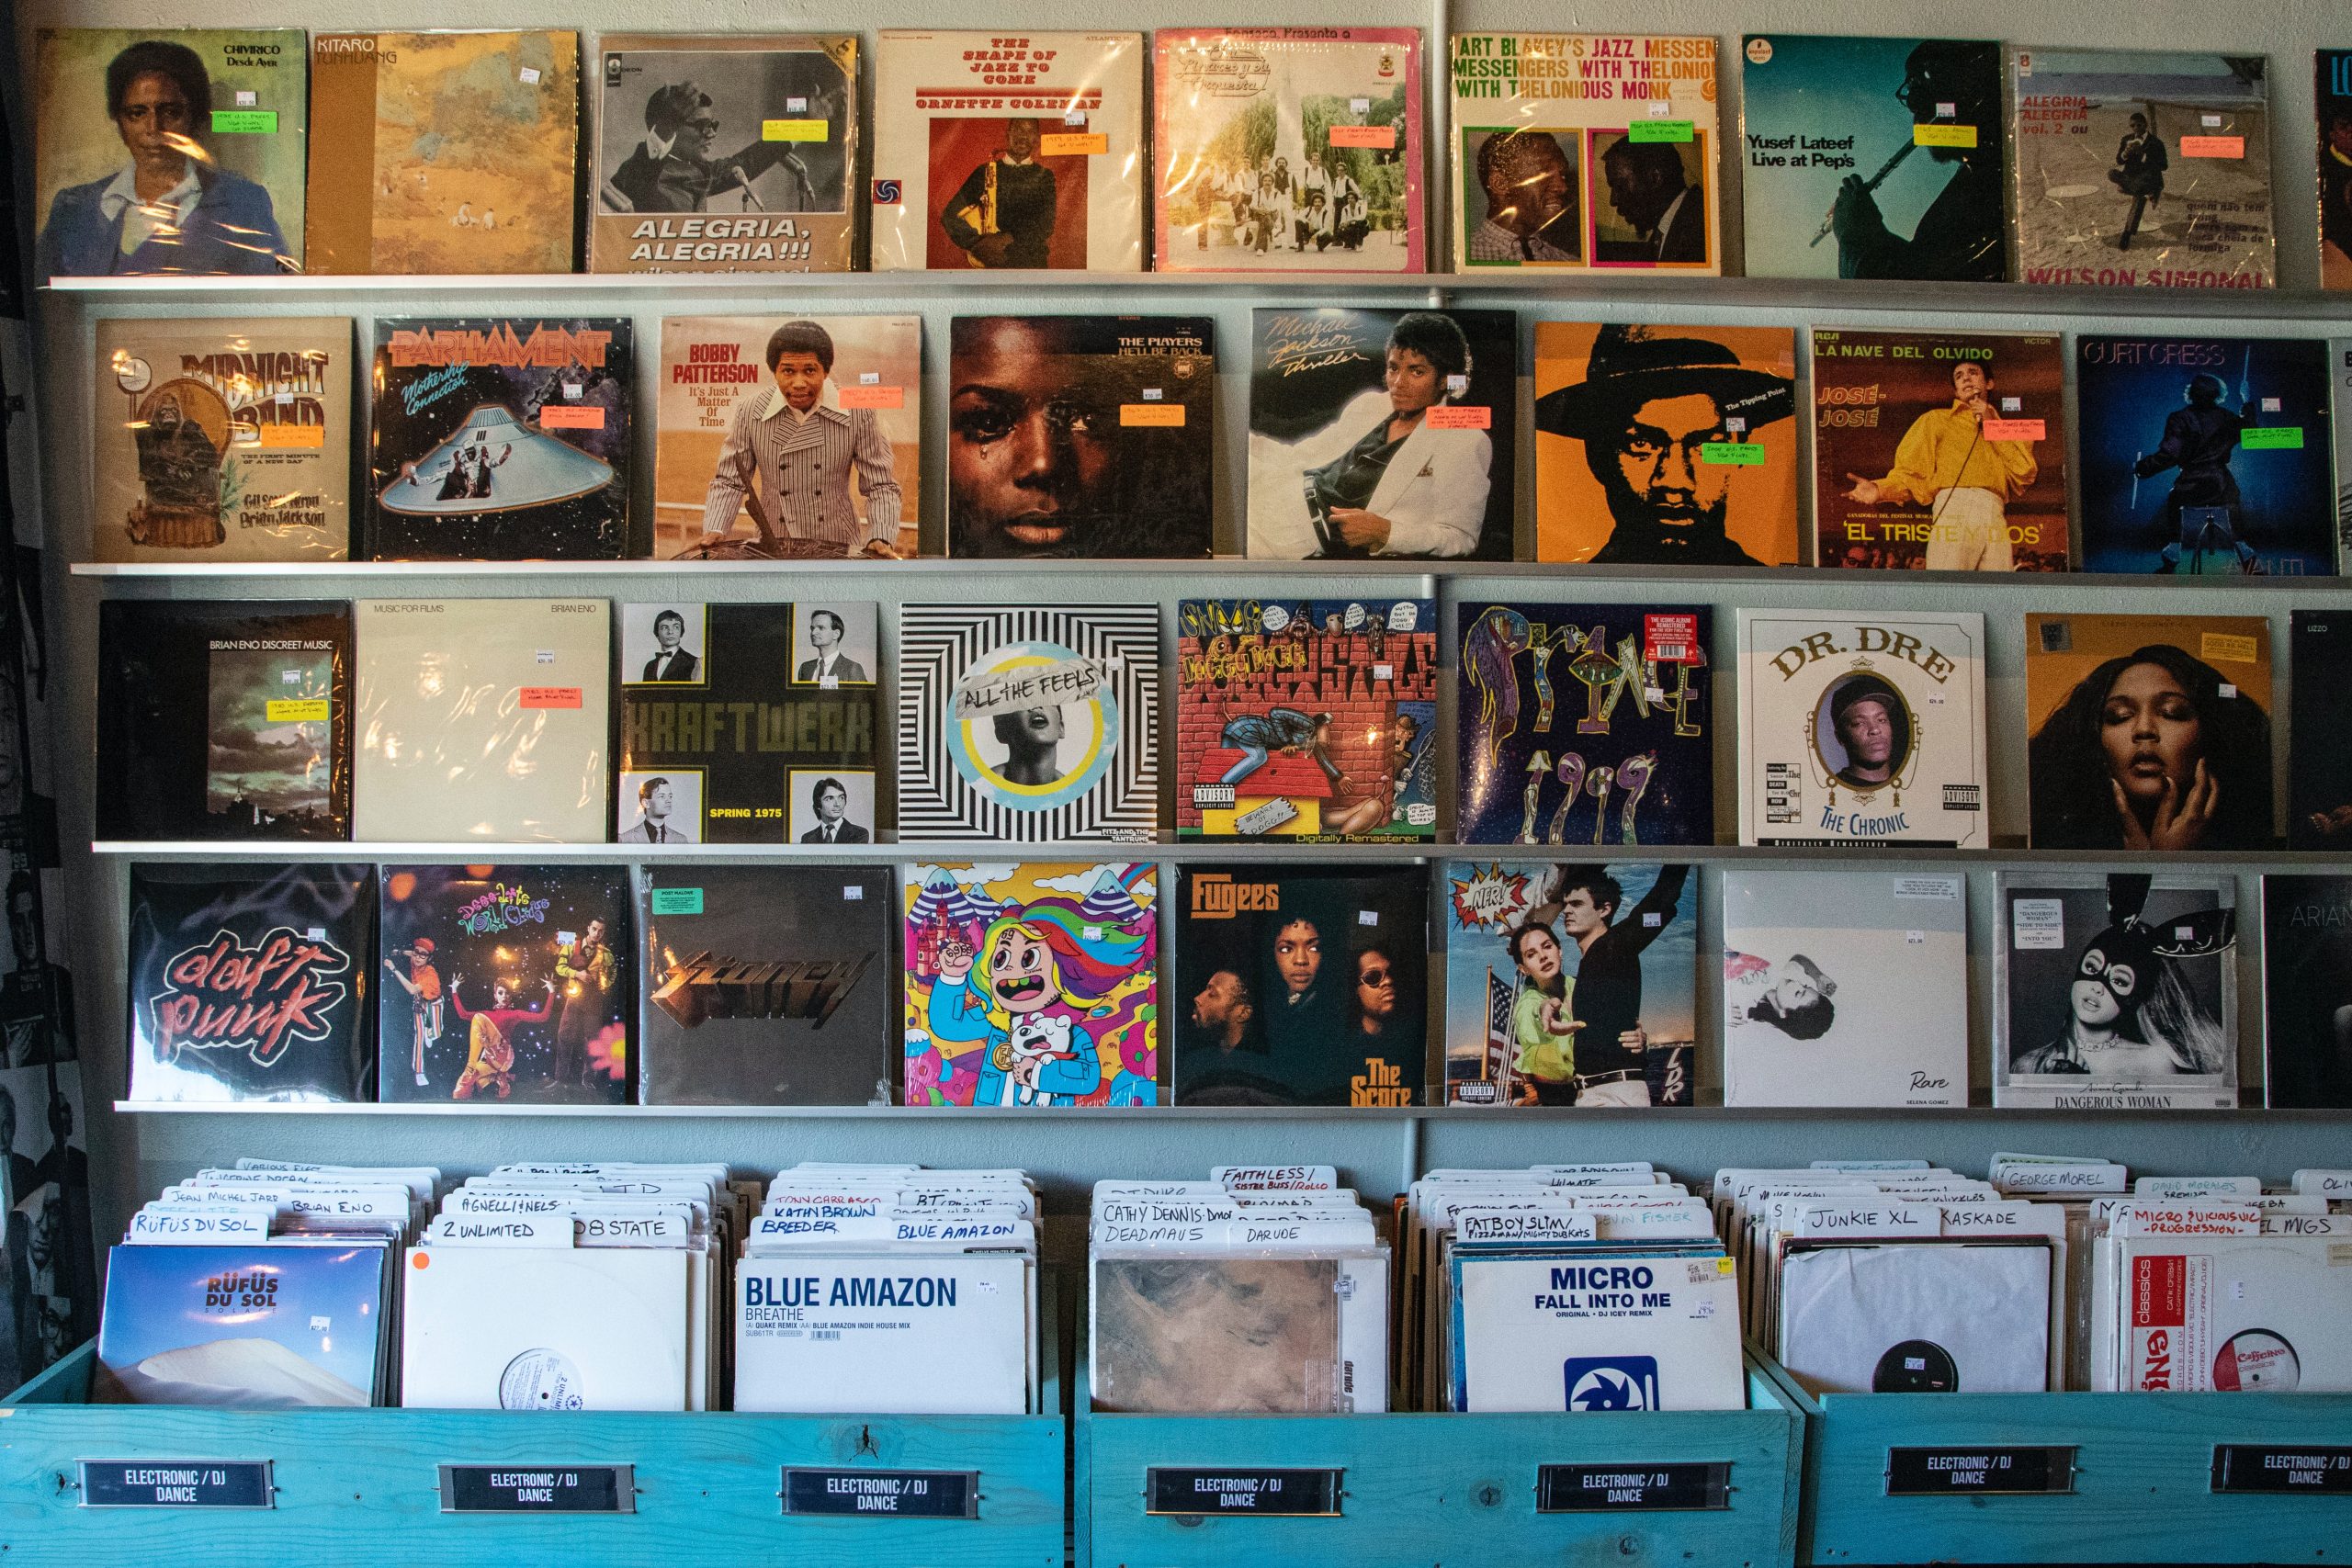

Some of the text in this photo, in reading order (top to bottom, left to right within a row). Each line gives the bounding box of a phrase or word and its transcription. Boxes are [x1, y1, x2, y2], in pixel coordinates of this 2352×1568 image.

[223, 45, 281, 55] CHIVIRICO
[317, 39, 375, 52] KITARO
[990, 39, 1030, 48] THE
[1459, 38, 1634, 58] ART BLAKEY'S JAZZ
[316, 51, 397, 64] TUNHUANG
[962, 51, 1057, 61] SHAPE OF
[969, 62, 1050, 73] JAZZ TO
[1453, 59, 1623, 79] MESSENGERS WITH
[983, 74, 1036, 85] COME
[1455, 79, 1672, 100] WITH THELONIOUS MONK
[915, 99, 1102, 109] ORNETTE COLEMAN
[2022, 96, 2087, 107] ALEGRIA
[2022, 109, 2088, 120] ALEGRIA
[1747, 135, 1855, 150] Yusef Lateef
[1751, 152, 1855, 170] Live at Pep's
[631, 219, 810, 240] ALEGRIA,
[629, 243, 810, 261] ALEGRIA!!!
[2027, 268, 2266, 288] WILSON SIMONAL
[1265, 313, 1363, 340] Michael
[387, 321, 613, 372] PARLIAMENT
[1118, 337, 1203, 346] THE PLAYERS
[689, 344, 741, 363] BOBBY
[1170, 347, 1203, 356] BACK
[1815, 344, 1994, 360] LA NAVE DEL OLVIDO
[2085, 342, 2224, 366] CURT CRESS
[1283, 351, 1370, 378] Thriller
[673, 364, 759, 383] PATTERSON
[180, 352, 329, 410] MIDNIGHT
[401, 359, 471, 403] Mothership
[405, 376, 469, 416] Connection
[707, 387, 729, 397] Just
[1739, 393, 1768, 406] Tipping
[1766, 387, 1786, 398] Point
[697, 397, 731, 407] Matter
[707, 407, 718, 417] Of
[1819, 406, 1880, 427] JOSÉ
[699, 416, 725, 426] Time
[374, 604, 445, 613] MUSIC FOR FILMS
[551, 604, 596, 613] BRIAN ENO
[209, 640, 333, 649] BRIAN ENO DISCREET MUSIC
[1769, 626, 1956, 684] DR. DRE
[964, 667, 1096, 709] ALL FEELS
[628, 702, 871, 752] KRAFTWERK
[1194, 788, 1235, 801] ADVISORY
[1944, 791, 1979, 802] ADVISORY
[709, 808, 782, 818] SPRING 1975
[1111, 835, 1149, 843] TANTRUMS
[1295, 834, 1419, 843] Digitally Remastered
[1190, 873, 1280, 919] Fugees
[1471, 883, 1508, 910] NFR!
[173, 935, 339, 1000] daft
[161, 974, 334, 1057] punk
[1365, 1057, 1401, 1087] The
[1909, 1071, 1949, 1091] Rare
[1351, 1076, 1412, 1108] Score
[1461, 1086, 1494, 1096] ADVISORY
[2054, 1096, 2171, 1109] DANGEROUS WOMAN
[1221, 1168, 1306, 1182] FAITHLESS
[2008, 1171, 2105, 1187] GEORGE MOREL
[208, 1190, 247, 1202] MICHEL
[291, 1200, 373, 1213] BRIAN ENO
[1103, 1205, 1148, 1224] CATHY
[1642, 1212, 1692, 1224] FISHER
[1807, 1209, 1918, 1228] JUNKIE XL
[1940, 1209, 2018, 1226] KASKADE
[2134, 1210, 2183, 1223] MICRO
[135, 1213, 258, 1233] RÜFÜS DU SOL
[459, 1223, 535, 1237] UNLIMITED
[609, 1221, 667, 1236] STATE
[761, 1220, 840, 1234] BREEDER
[1464, 1216, 1524, 1232] FATBOY
[2284, 1218, 2332, 1235] MIGS
[897, 1224, 1015, 1239] BLUE AMAZON
[1247, 1226, 1301, 1242] DARUDE
[207, 1272, 278, 1293] RÜFÜS
[1550, 1265, 1655, 1291] MICRO
[745, 1277, 956, 1307] BLUE AMAZON
[2136, 1259, 2151, 1324] classics
[206, 1293, 277, 1307] DU SOL
[1534, 1292, 1672, 1310] FALL INTO ME
[745, 1307, 804, 1321] BREATHE
[1928, 1456, 1988, 1469] ELECTRONIC
[2265, 1456, 2326, 1469] ELECTRONIC
[126, 1470, 198, 1484] ELECTRONIC
[491, 1473, 554, 1486] ELECTRONIC
[1582, 1474, 1645, 1487] ELECTRONIC
[1951, 1472, 1984, 1483] DANCE
[2289, 1472, 2323, 1483] DANCE
[827, 1478, 899, 1493] ELECTRONIC
[1194, 1479, 1258, 1491] ELECTRONIC
[156, 1487, 197, 1501] DANCE
[517, 1488, 552, 1501] DANCE
[1221, 1494, 1255, 1506] DANCE
[1608, 1489, 1642, 1502] DANCE
[857, 1495, 897, 1510] DANCE
